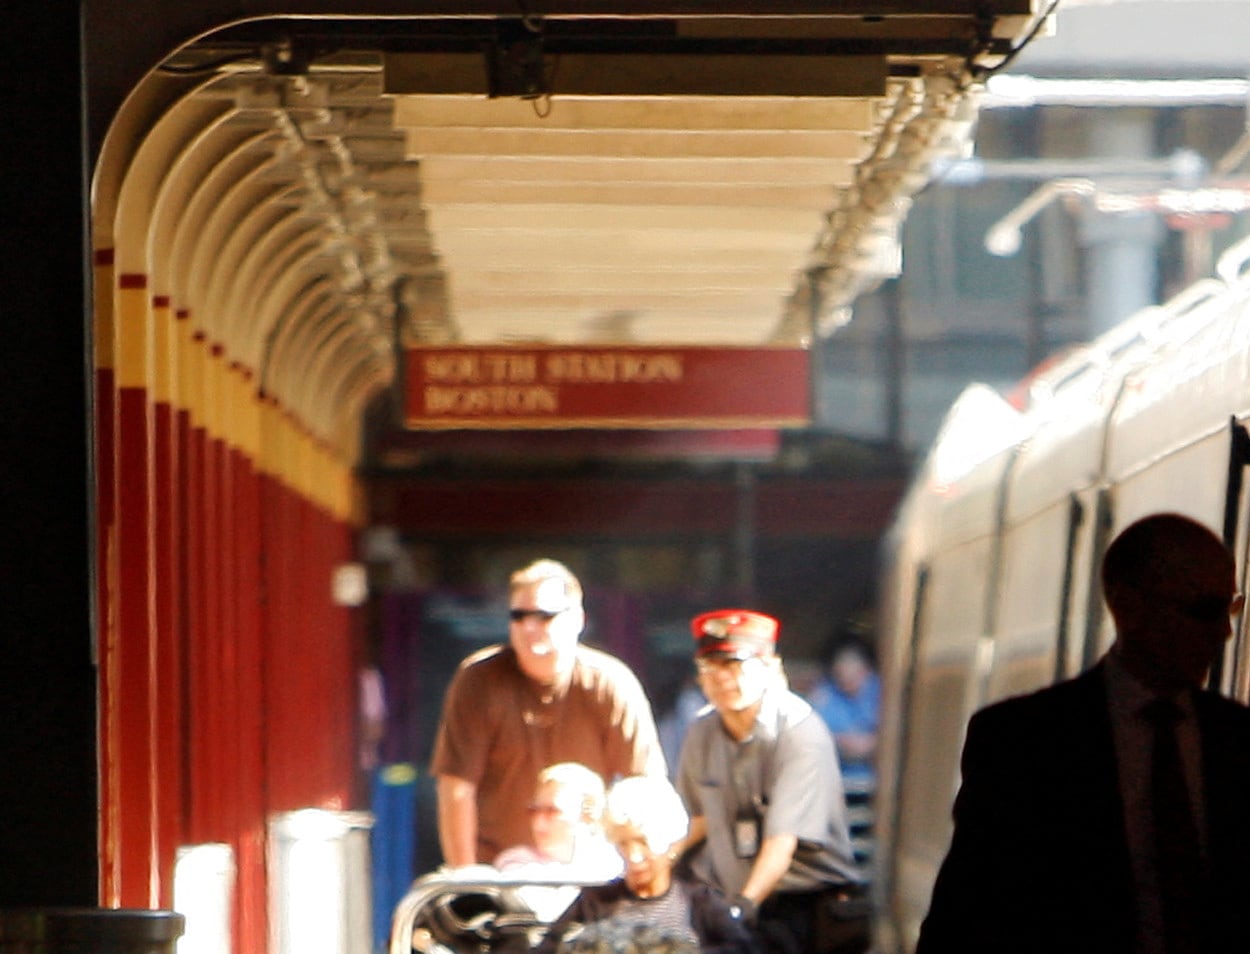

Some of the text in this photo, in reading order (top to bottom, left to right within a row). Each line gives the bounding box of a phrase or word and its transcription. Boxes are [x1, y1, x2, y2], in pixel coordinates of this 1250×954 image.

[424, 353, 684, 382] SOUTH STATION
[424, 385, 560, 414] BOSTON
